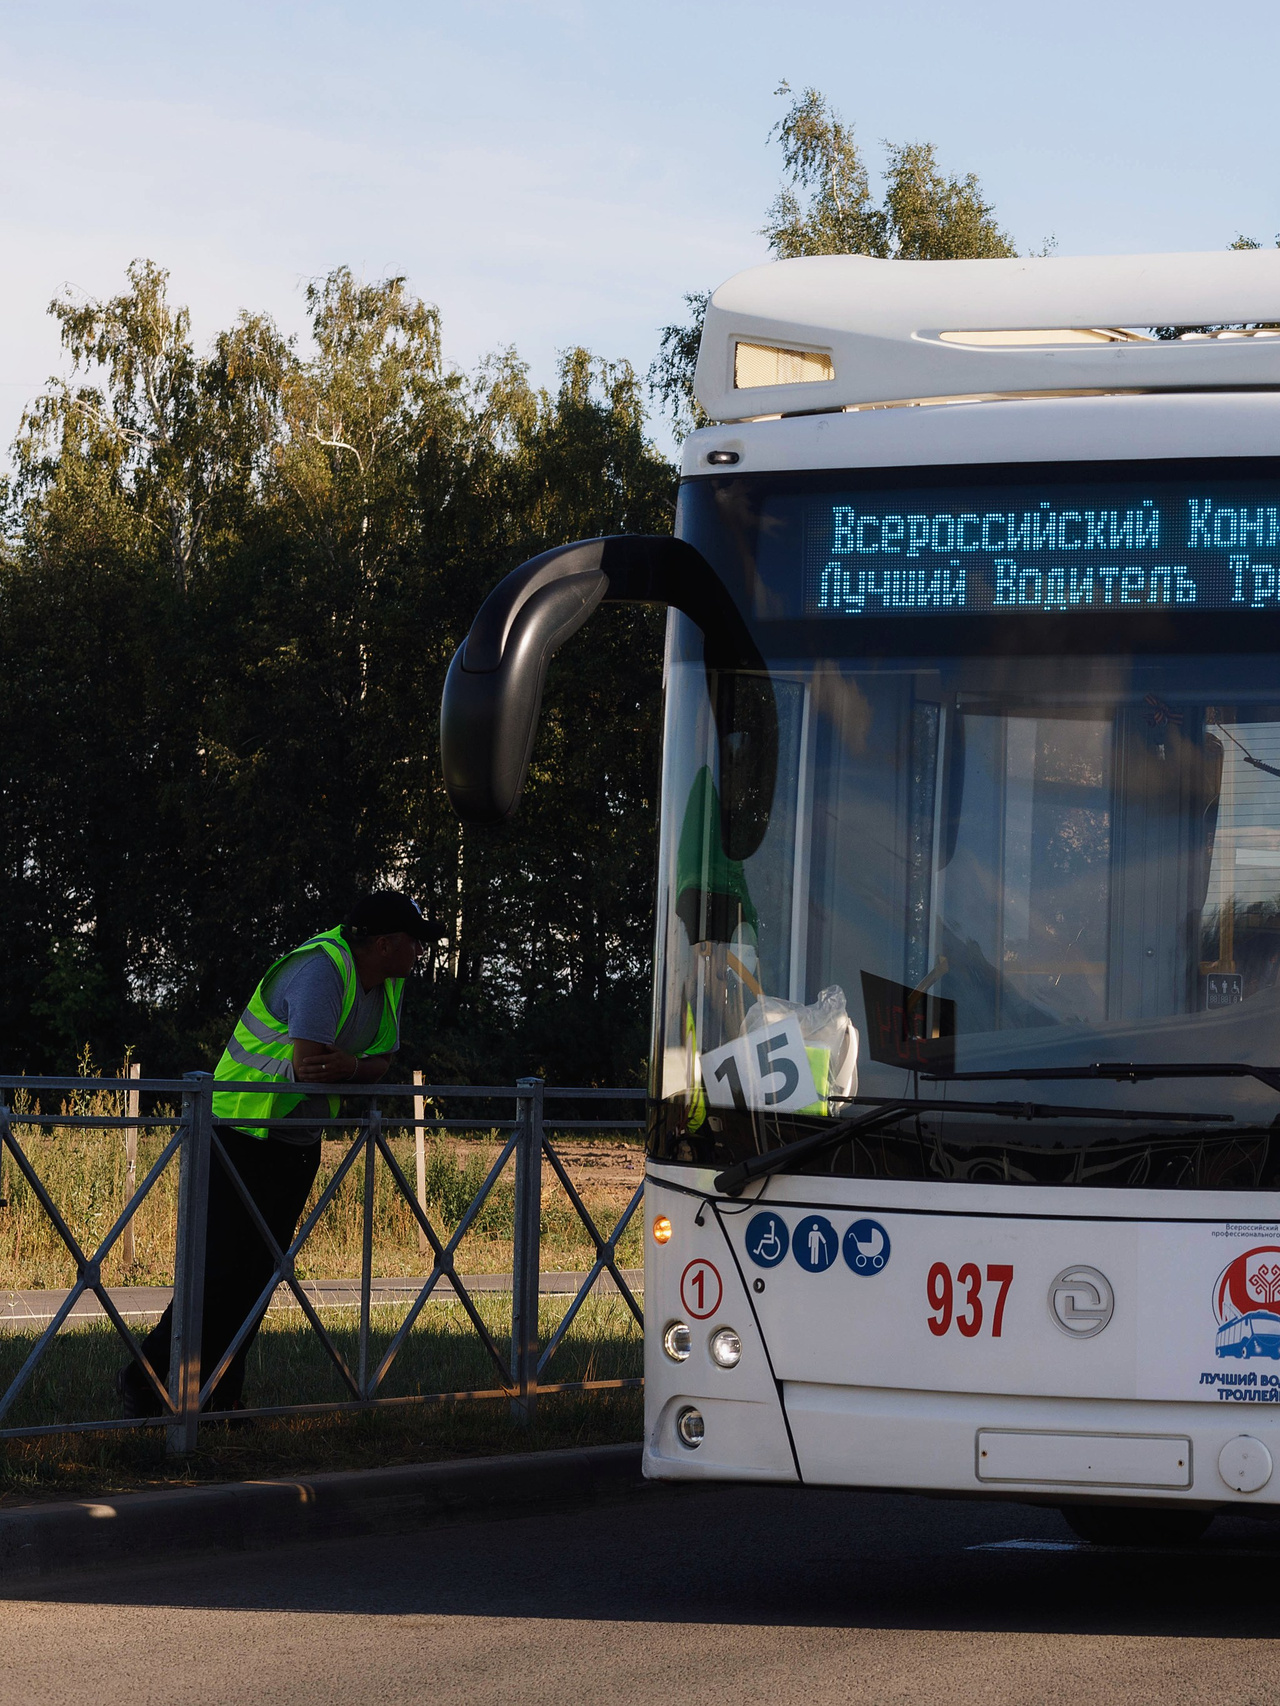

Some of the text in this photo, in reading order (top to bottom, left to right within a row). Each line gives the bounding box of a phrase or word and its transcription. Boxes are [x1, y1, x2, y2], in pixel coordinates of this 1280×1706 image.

[832, 500, 1159, 557] Всероссийский
[818, 560, 966, 613] Лучший
[993, 558, 1197, 611] Водитель
[714, 1033, 799, 1111] 15
[1211, 1231, 1280, 1239] профессионального
[1225, 1223, 1279, 1231] Всероссийский
[691, 1270, 704, 1309] 1
[927, 1262, 1014, 1337] 937
[1199, 1372, 1257, 1386] ЛУЧШИЙ
